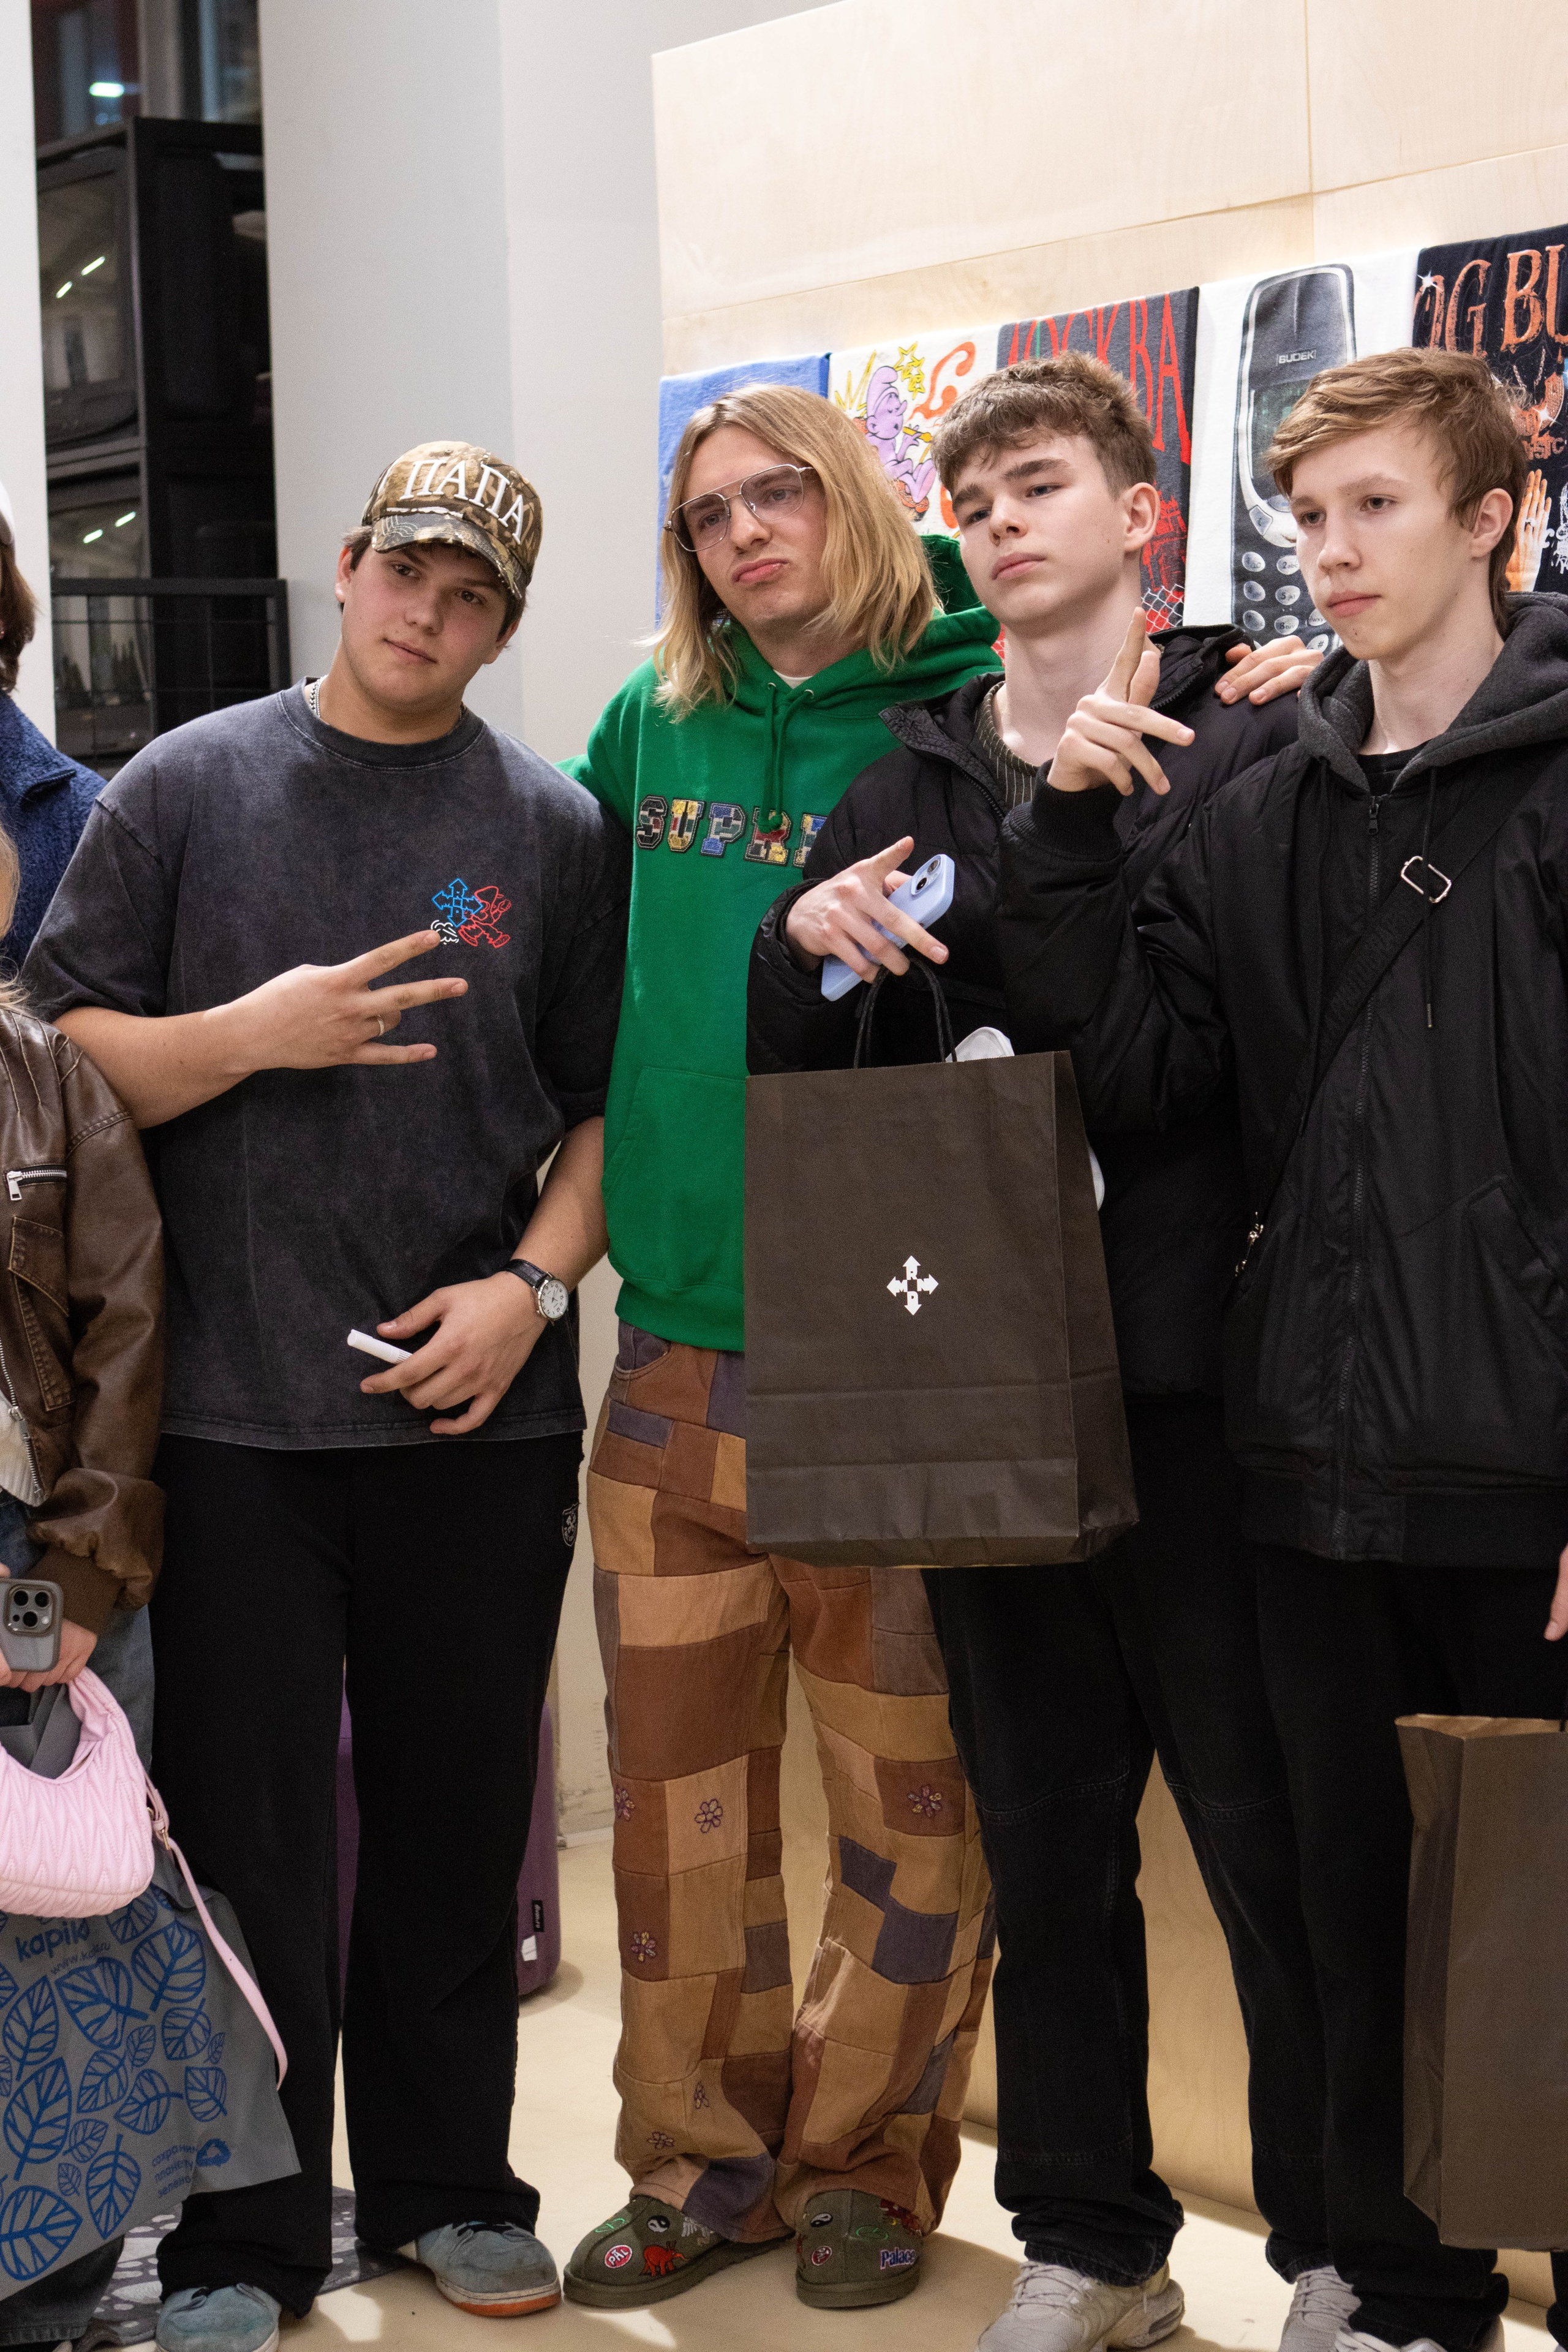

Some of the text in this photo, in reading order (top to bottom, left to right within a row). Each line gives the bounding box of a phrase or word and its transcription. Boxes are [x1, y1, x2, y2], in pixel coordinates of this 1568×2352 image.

[399, 460, 524, 545] ПАПА
[157, 2175, 191, 2197] зелено
[608, 2249, 629, 2266] PAL
[880, 2247, 916, 2270] Palace
